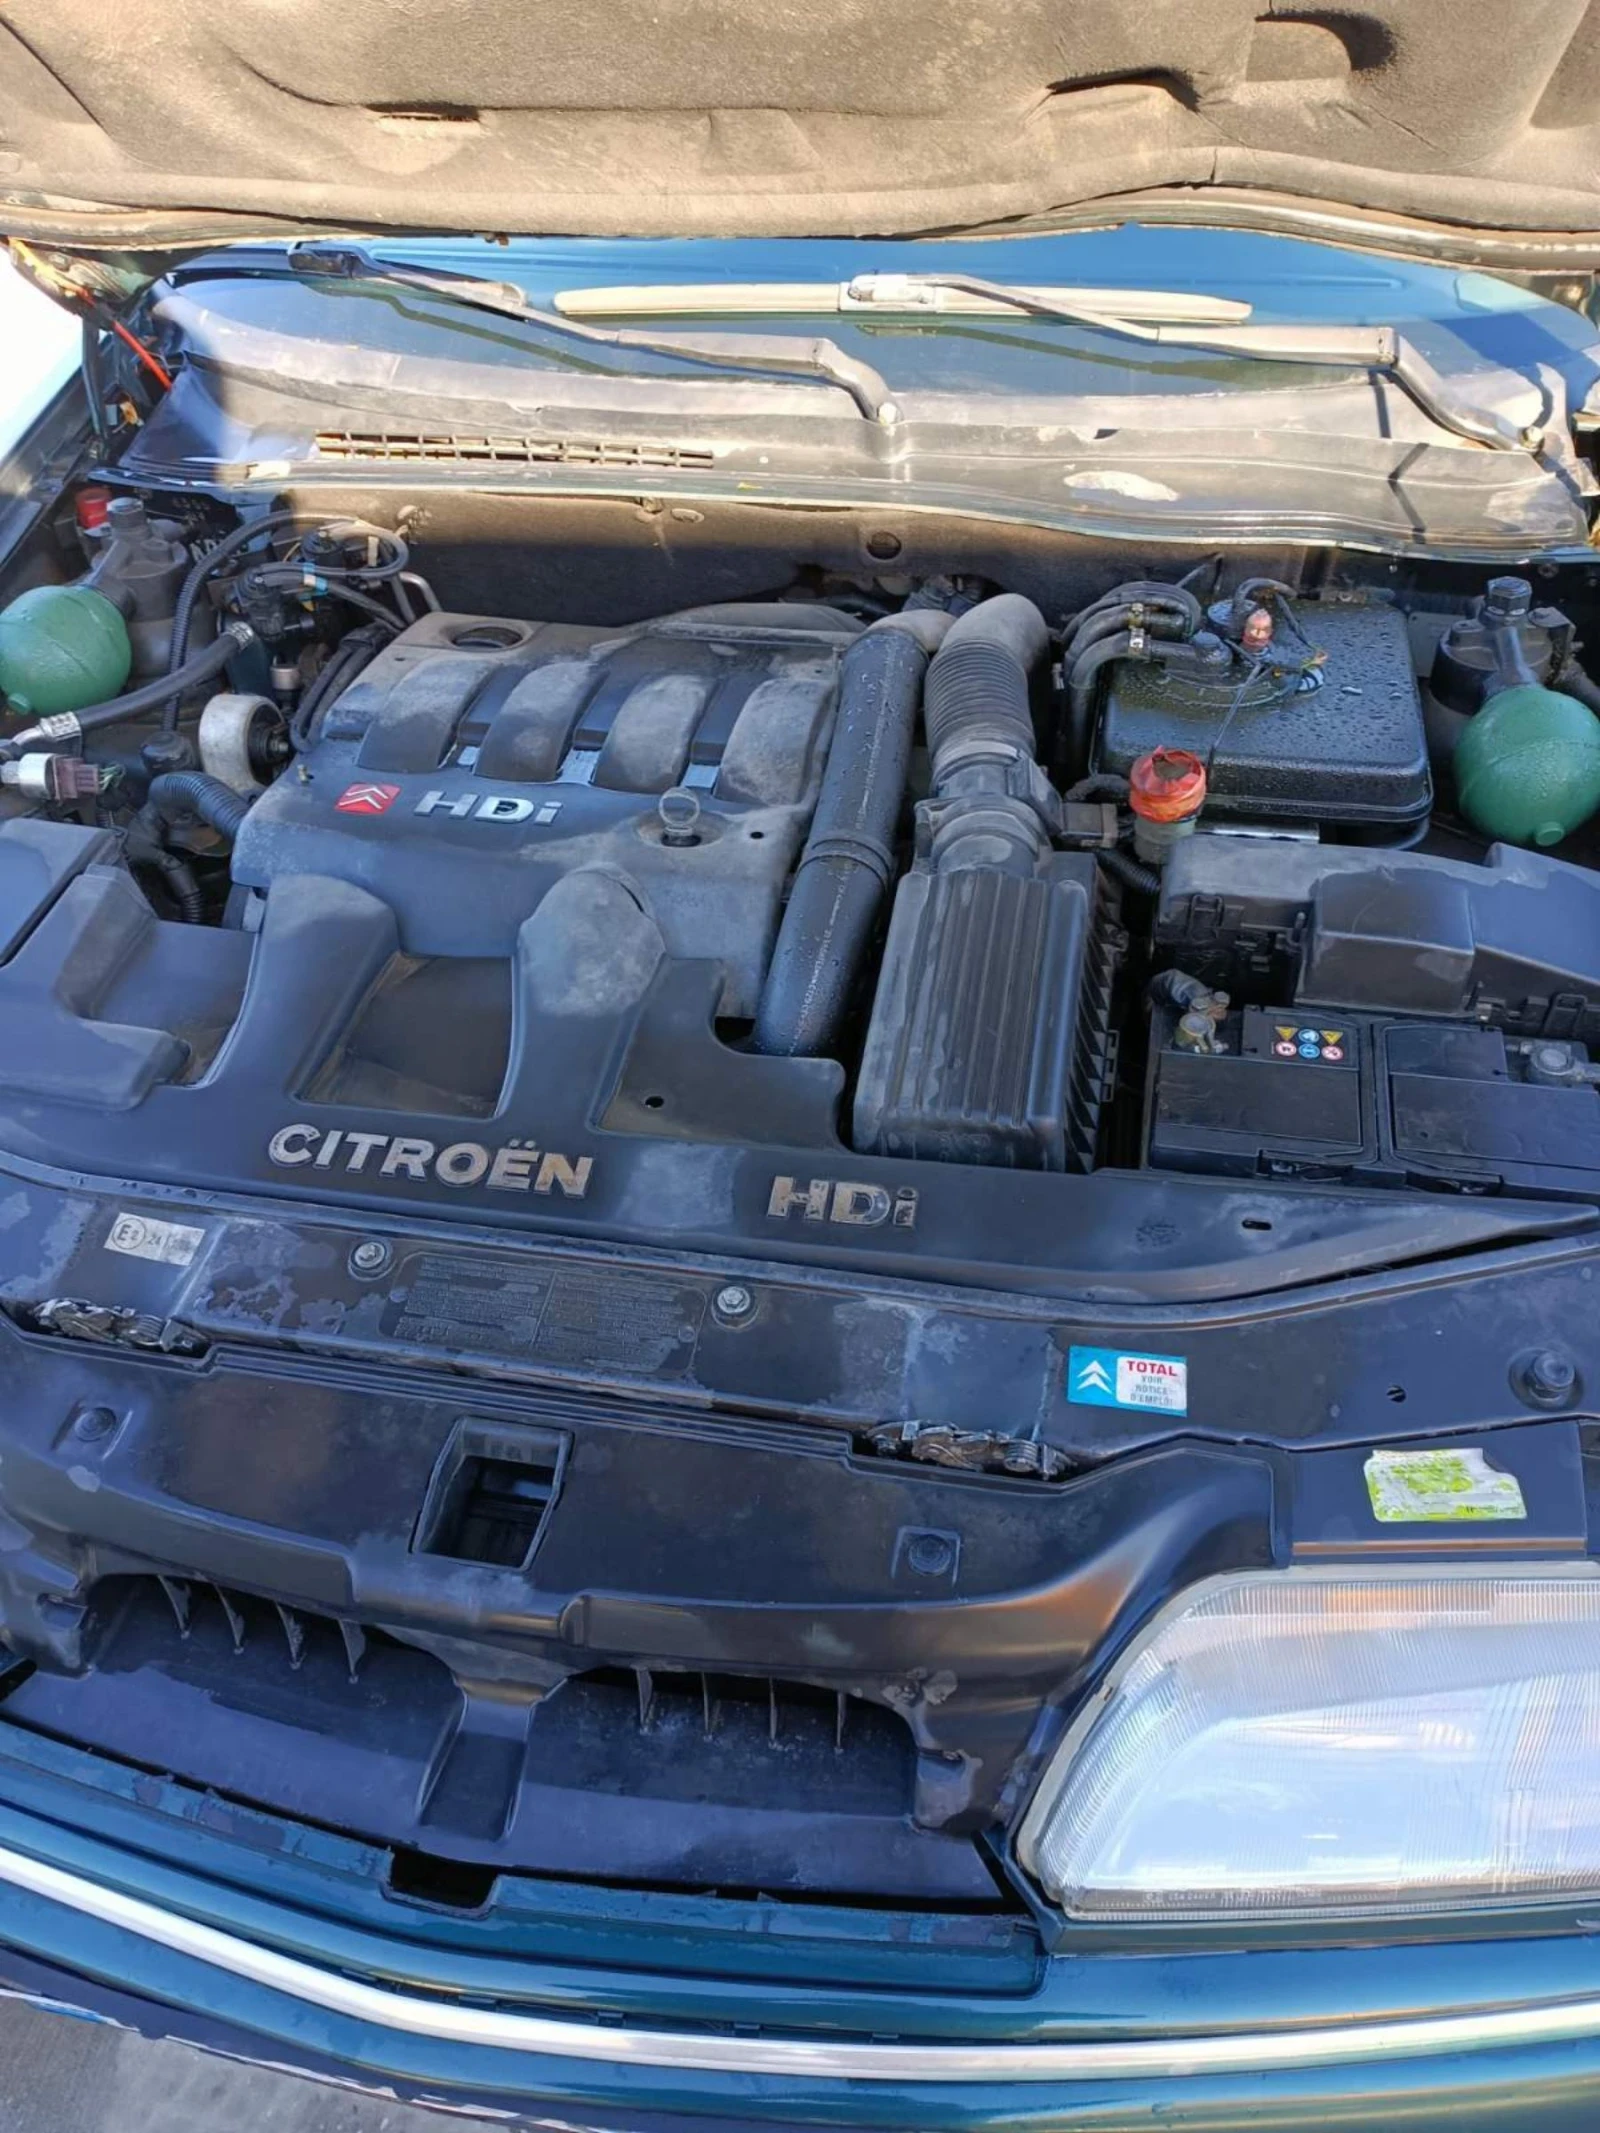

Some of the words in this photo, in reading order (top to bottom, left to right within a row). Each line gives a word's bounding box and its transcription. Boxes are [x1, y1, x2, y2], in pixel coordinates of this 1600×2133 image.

[414, 790, 563, 826] HDi
[268, 1123, 593, 1199] CITROËN
[767, 1175, 918, 1227] HDi
[1127, 1360, 1178, 1376] TOTAL
[1135, 1384, 1168, 1394] NOTICE
